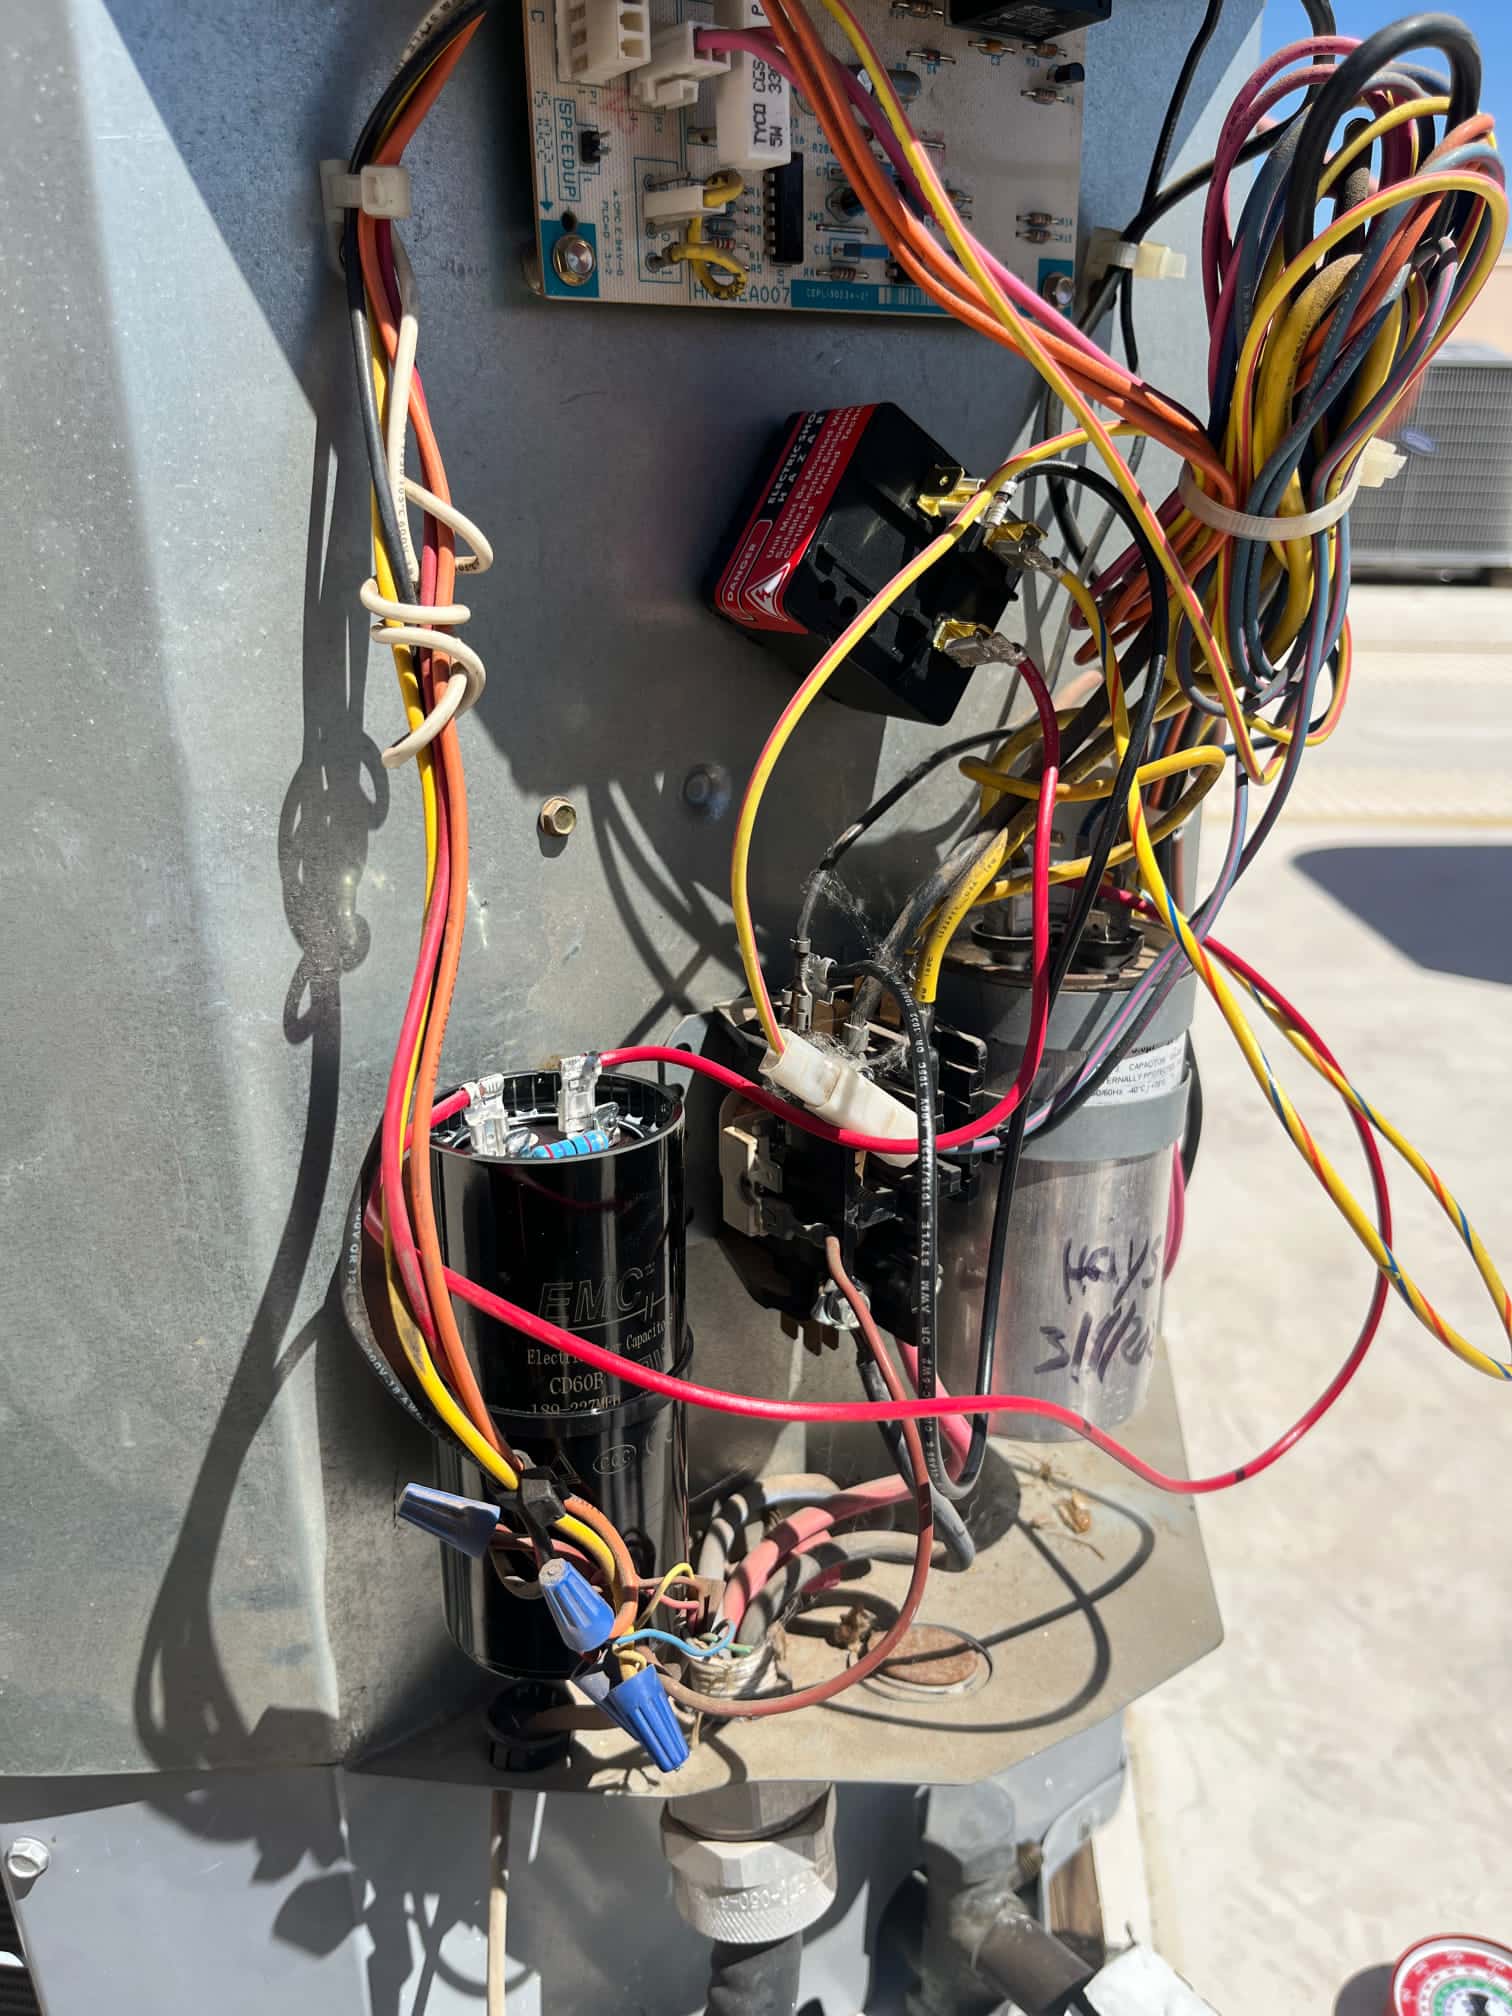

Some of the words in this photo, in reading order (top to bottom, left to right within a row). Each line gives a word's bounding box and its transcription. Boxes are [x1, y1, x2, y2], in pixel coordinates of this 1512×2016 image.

[752, 58, 766, 93] CGS
[768, 64, 782, 95] 33
[753, 103, 767, 145] TYCO
[559, 102, 577, 198] SPEEDUP
[767, 444, 801, 506] ELECTRIC
[727, 543, 756, 602] DANGER
[1106, 1072, 1143, 1085] ERNALLY
[921, 1221, 931, 1267] STYLE
[539, 1267, 643, 1323] EMC
[921, 1280, 931, 1313] AWM
[921, 1325, 931, 1344] OR
[527, 1347, 585, 1366] Electri
[550, 1371, 605, 1395] CD60B
